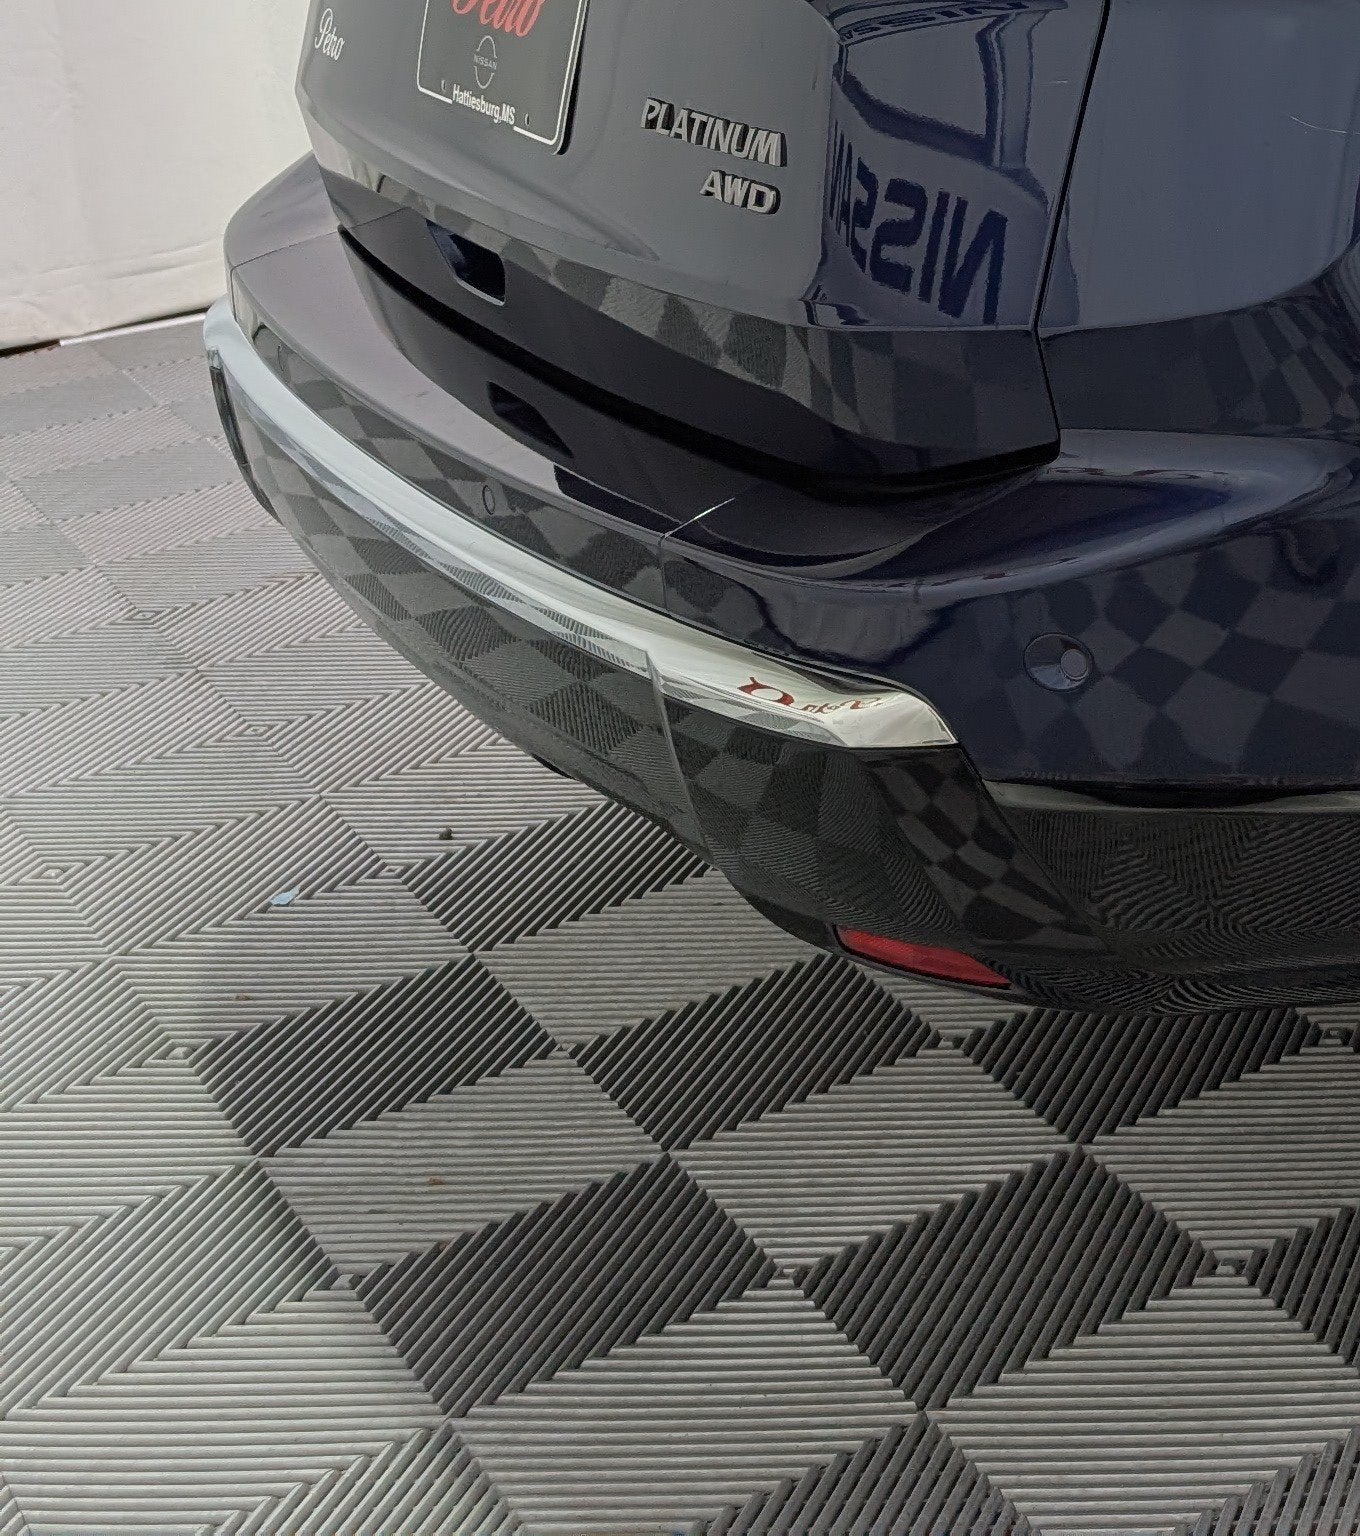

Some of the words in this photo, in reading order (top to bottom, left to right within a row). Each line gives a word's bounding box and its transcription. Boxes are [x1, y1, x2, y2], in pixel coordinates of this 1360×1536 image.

[314, 7, 346, 61] Petro
[473, 53, 498, 70] NISSAN
[640, 97, 788, 167] PLATINUM
[699, 169, 782, 215] AWD
